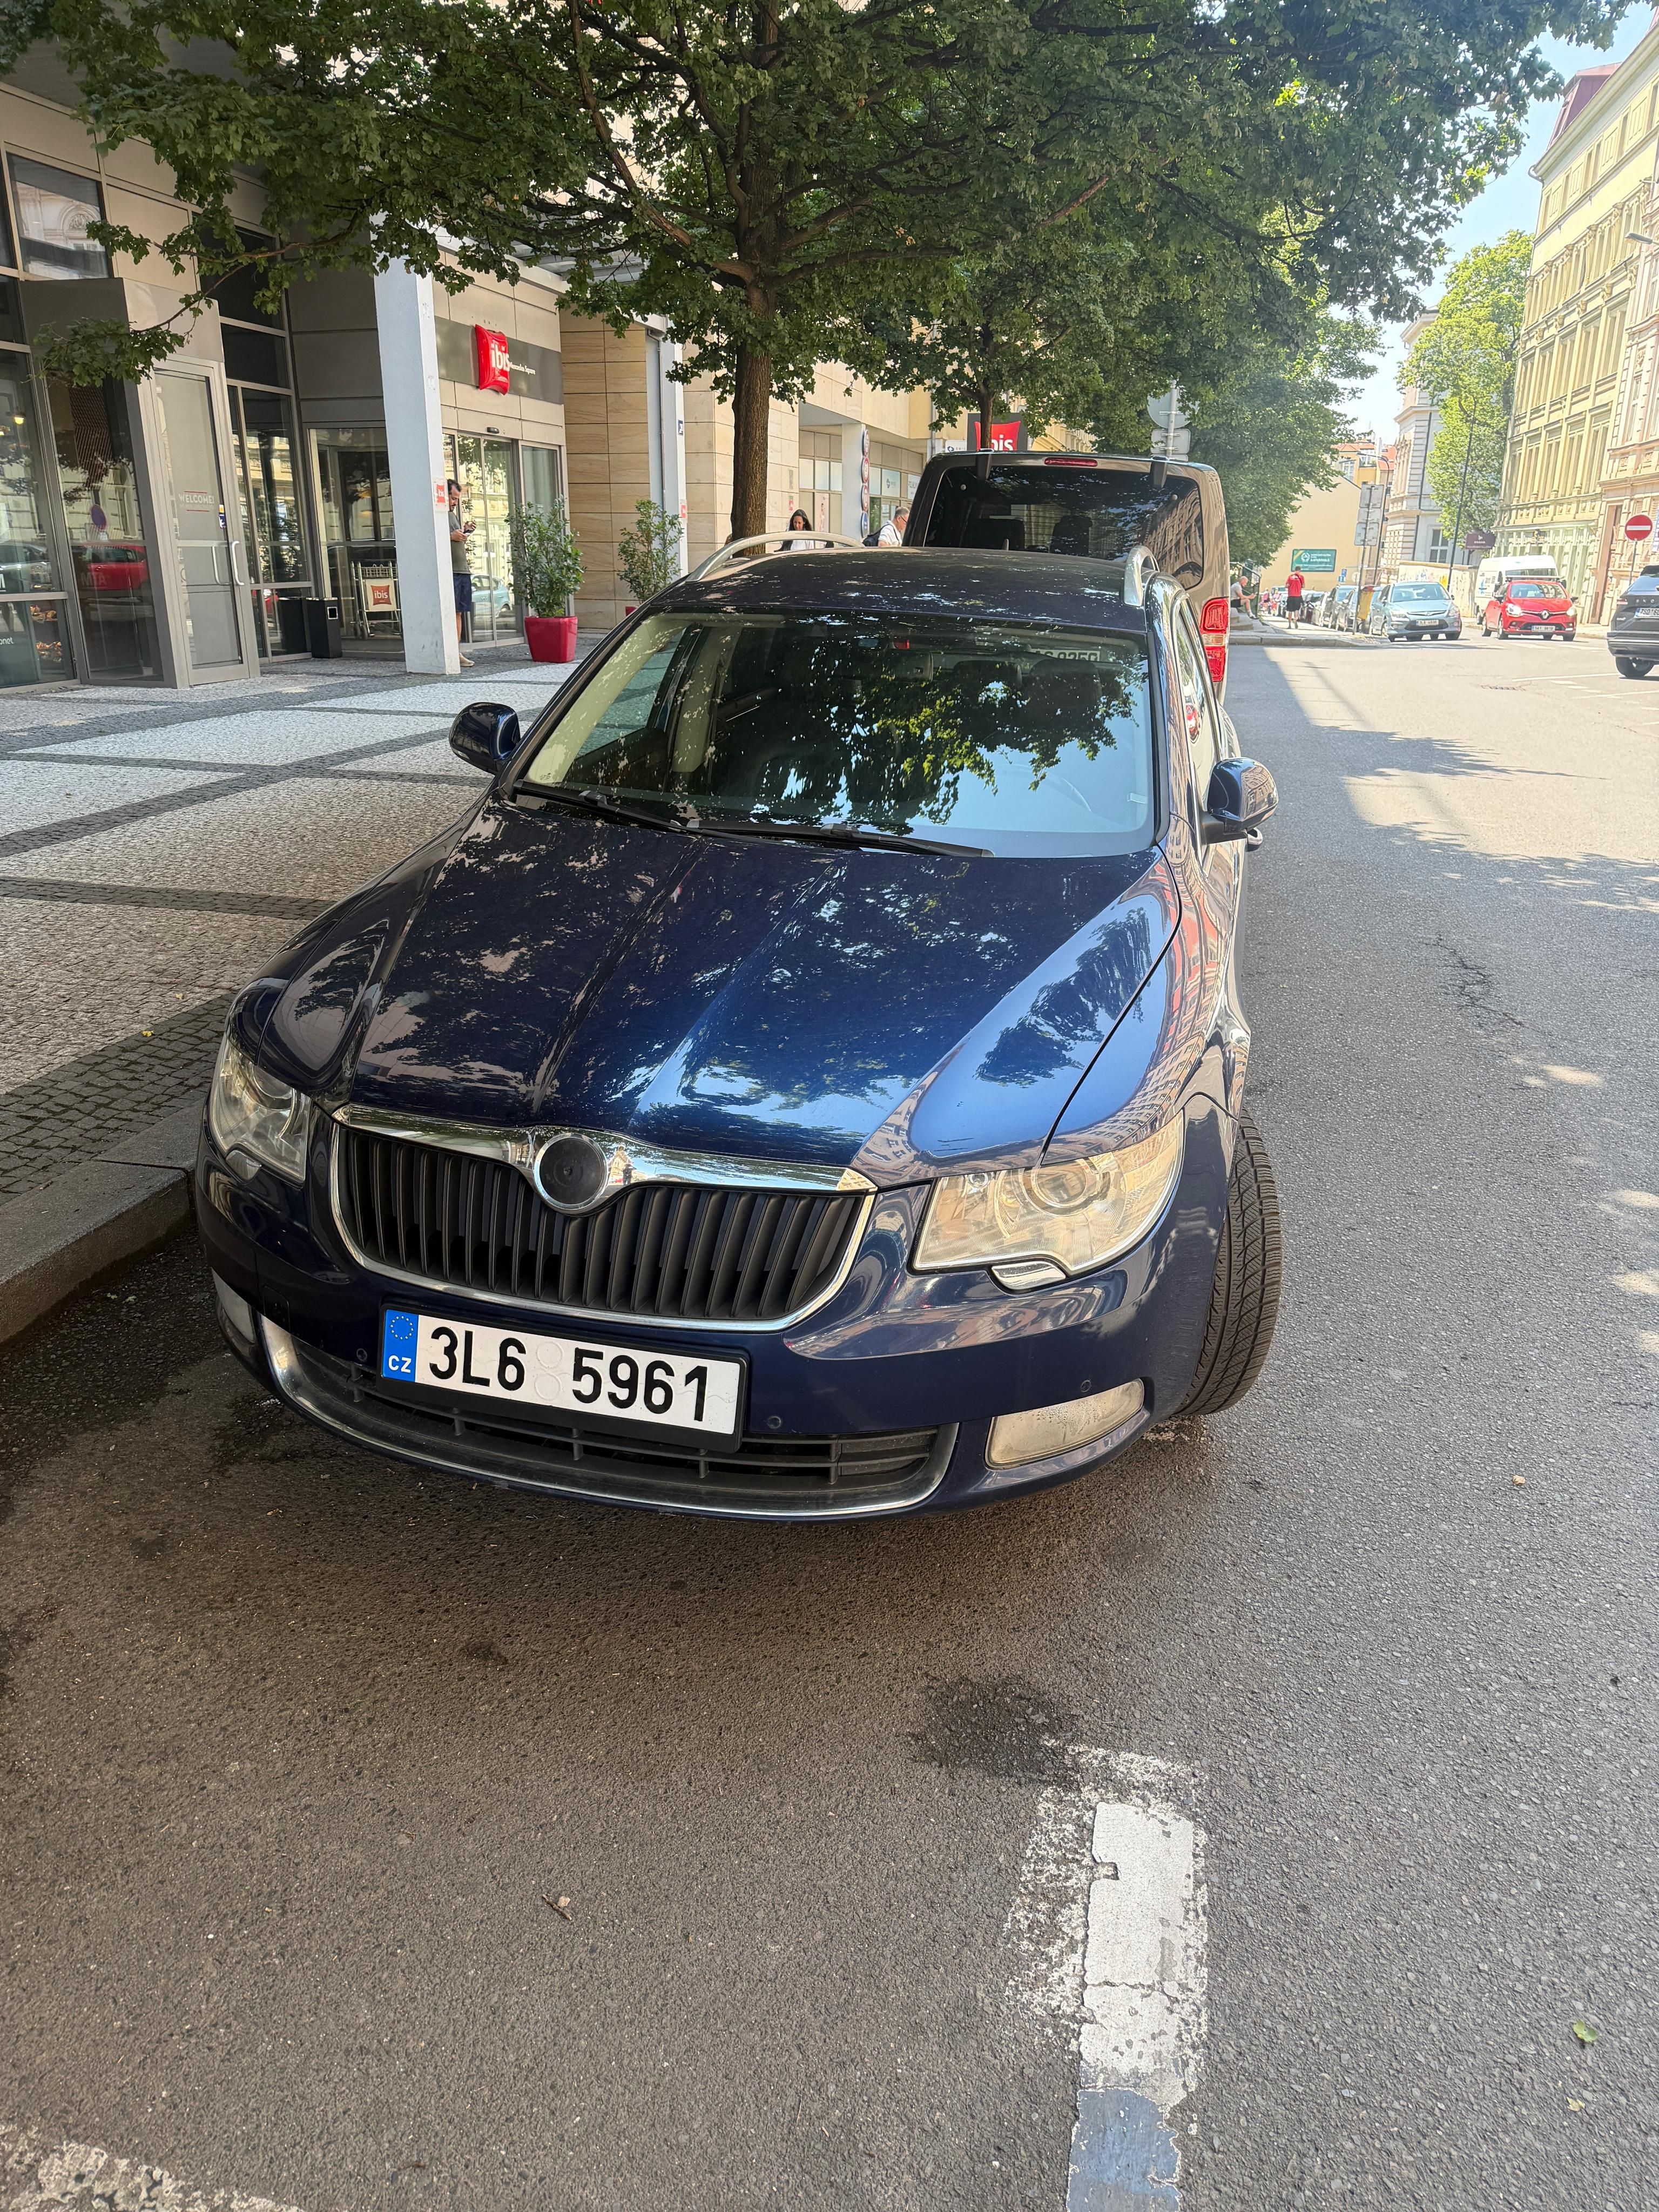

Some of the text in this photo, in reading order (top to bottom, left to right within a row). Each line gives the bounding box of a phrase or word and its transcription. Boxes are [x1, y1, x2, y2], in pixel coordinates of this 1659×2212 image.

[491, 342, 510, 372] ibis
[178, 493, 215, 504] WELCOME!
[374, 590, 388, 598] ibis
[388, 1355, 411, 1373] CZ
[429, 1326, 708, 1422] 3L6 5961
